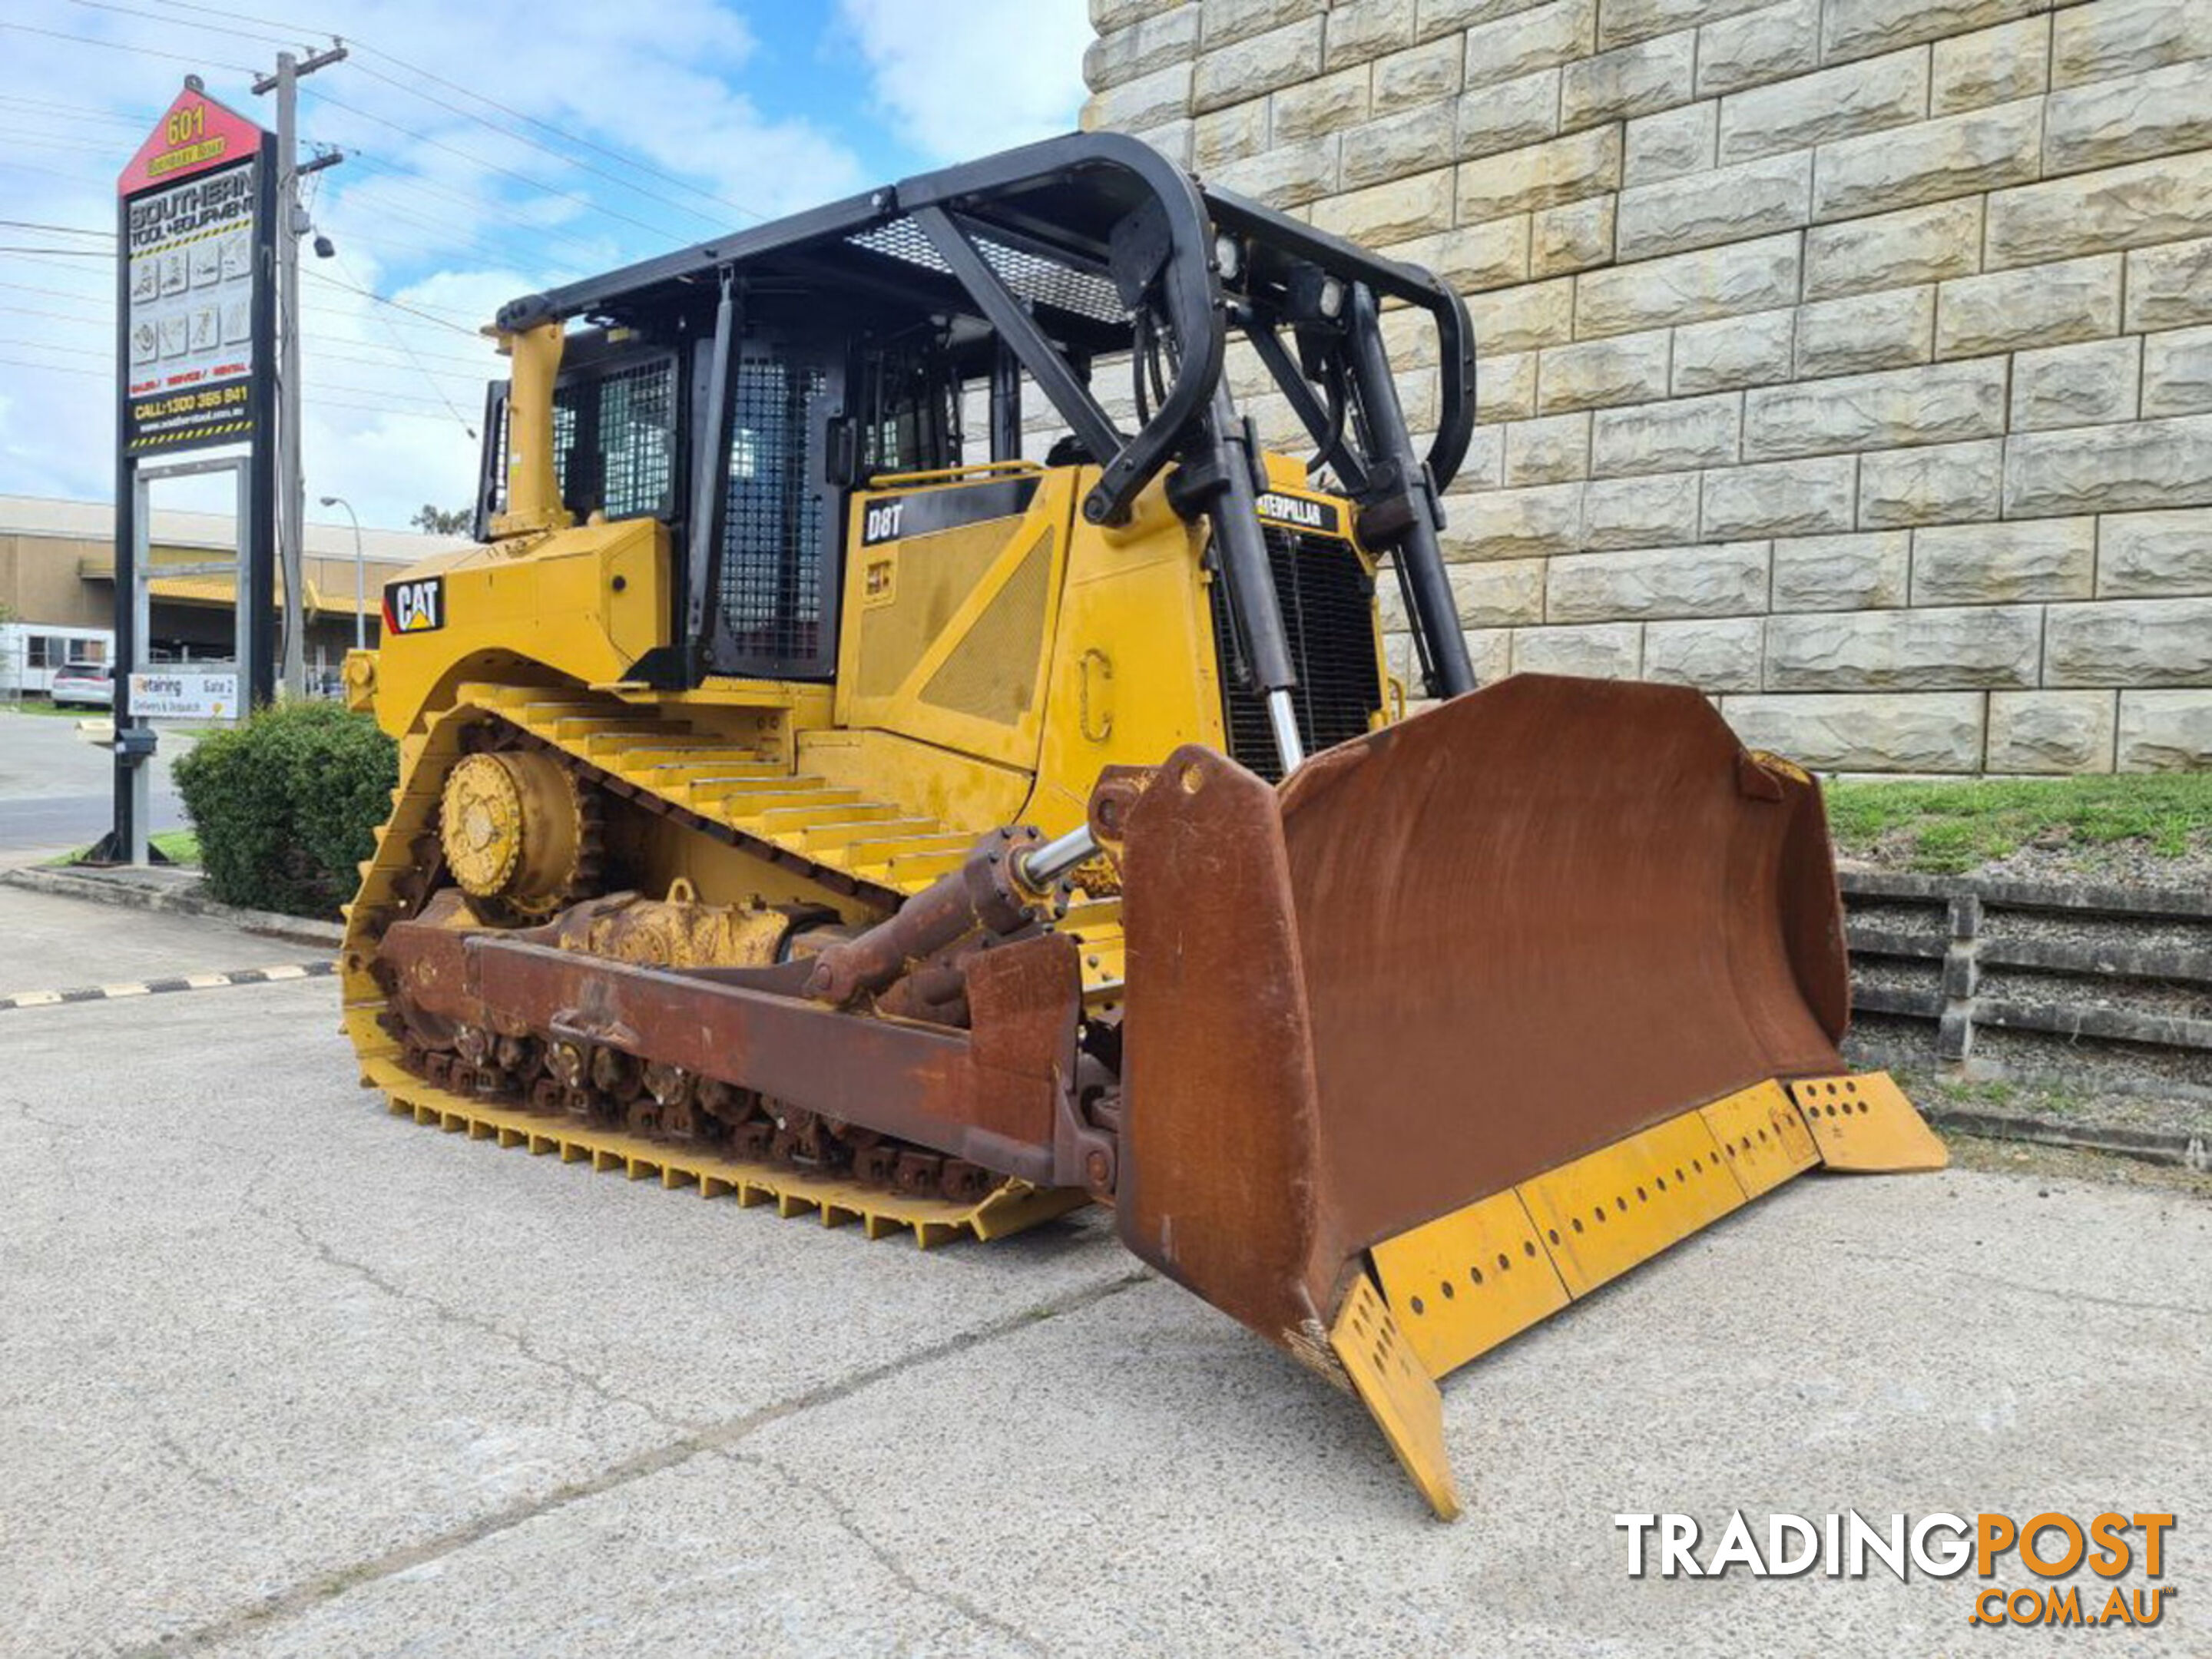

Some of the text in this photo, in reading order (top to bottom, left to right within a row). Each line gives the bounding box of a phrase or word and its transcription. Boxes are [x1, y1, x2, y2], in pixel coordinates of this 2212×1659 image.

[167, 104, 204, 145] 601
[130, 171, 253, 230] SOUTHERN
[866, 504, 903, 541] D8T
[397, 581, 438, 631] CAT
